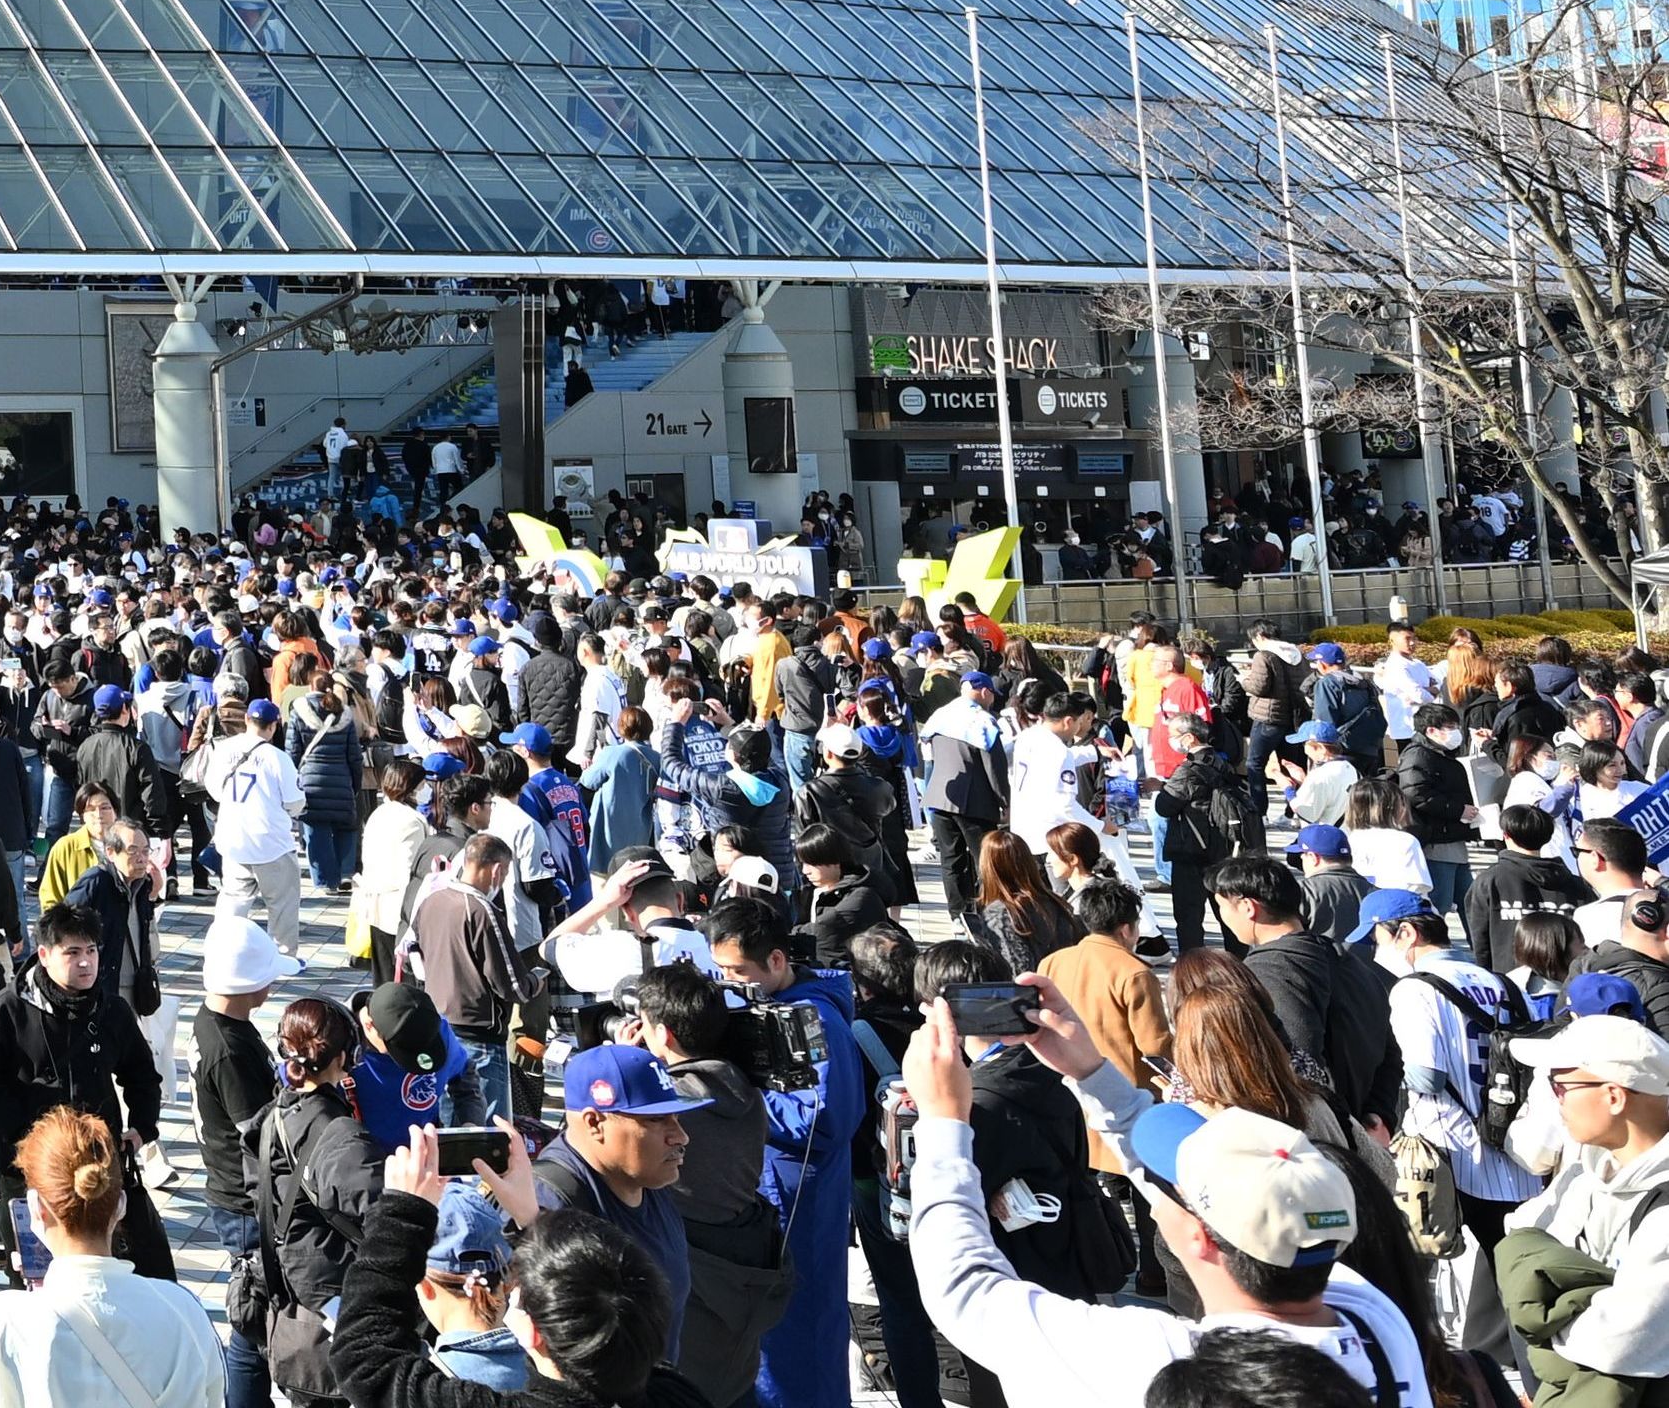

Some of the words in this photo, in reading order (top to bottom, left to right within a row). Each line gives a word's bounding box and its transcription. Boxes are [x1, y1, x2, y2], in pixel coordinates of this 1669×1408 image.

[906, 336, 983, 375] SHAKE
[986, 338, 1059, 372] SHACK
[1058, 391, 1108, 409] TICKETS
[646, 413, 665, 436] 21
[666, 424, 688, 436] GATE
[702, 553, 757, 575] WORLD
[757, 554, 802, 576] TOUR
[423, 648, 441, 672] LA
[687, 739, 723, 754] TOKYO
[231, 772, 257, 803] 17
